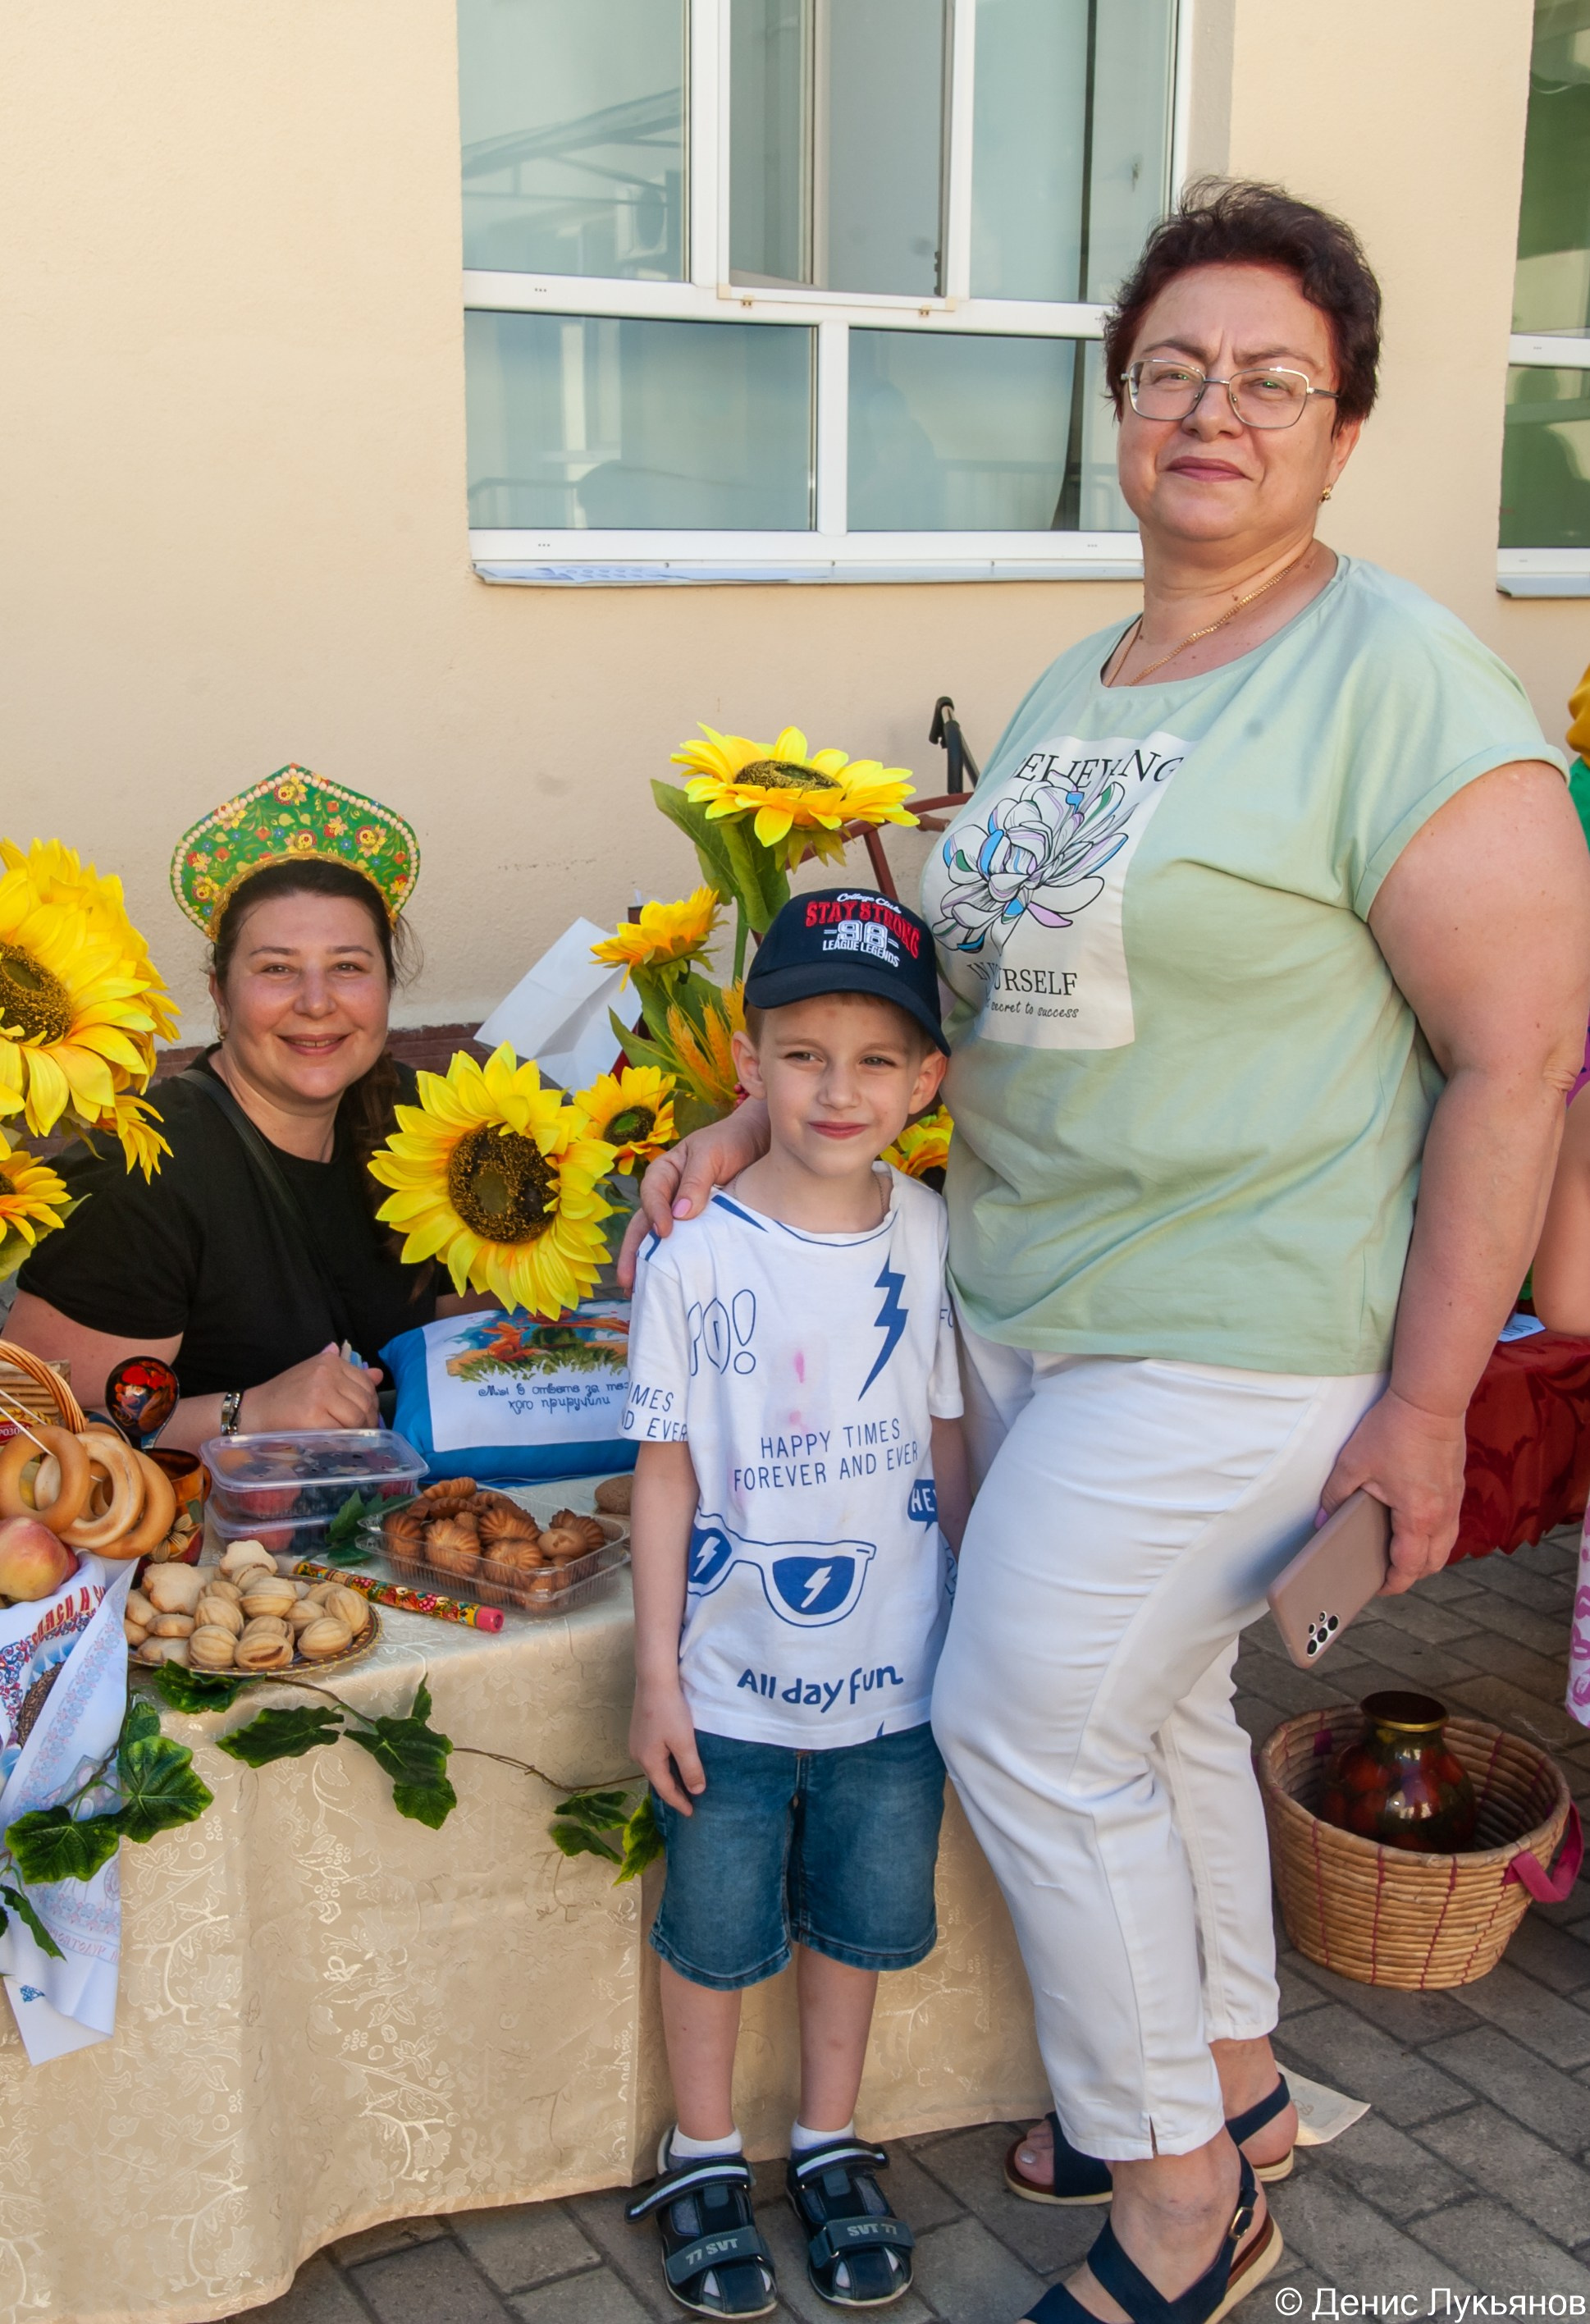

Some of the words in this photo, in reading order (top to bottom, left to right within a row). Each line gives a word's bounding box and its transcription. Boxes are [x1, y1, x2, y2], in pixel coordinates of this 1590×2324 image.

[806, 900, 858, 927] STAY
[859, 902, 920, 958] STRONG
[838, 919, 889, 949] 98
[823, 940, 860, 951] LEAGUE
[860, 941, 900, 968] LEGENDS
[991, 1000, 1021, 1013] secret
[1025, 1000, 1034, 1014] to
[1037, 1007, 1080, 1018] success
[478, 1384, 509, 1397] Мы
[532, 1383, 580, 1394] ответе
[585, 1384, 600, 1398] за
[628, 1381, 674, 1411] IMES
[508, 1399, 533, 1415] кого
[541, 1396, 610, 1415] приручили
[647, 1417, 688, 1442] EVER
[761, 1430, 831, 1459] HAPPY
[843, 1418, 901, 1448] TIMES
[734, 1462, 826, 1492] FOREVER
[839, 1453, 877, 1480] AND
[887, 1440, 918, 1471] EVER
[912, 1488, 937, 1512] HE
[737, 1668, 777, 1699] All
[782, 1678, 844, 1713] day
[850, 1665, 904, 1705] fun
